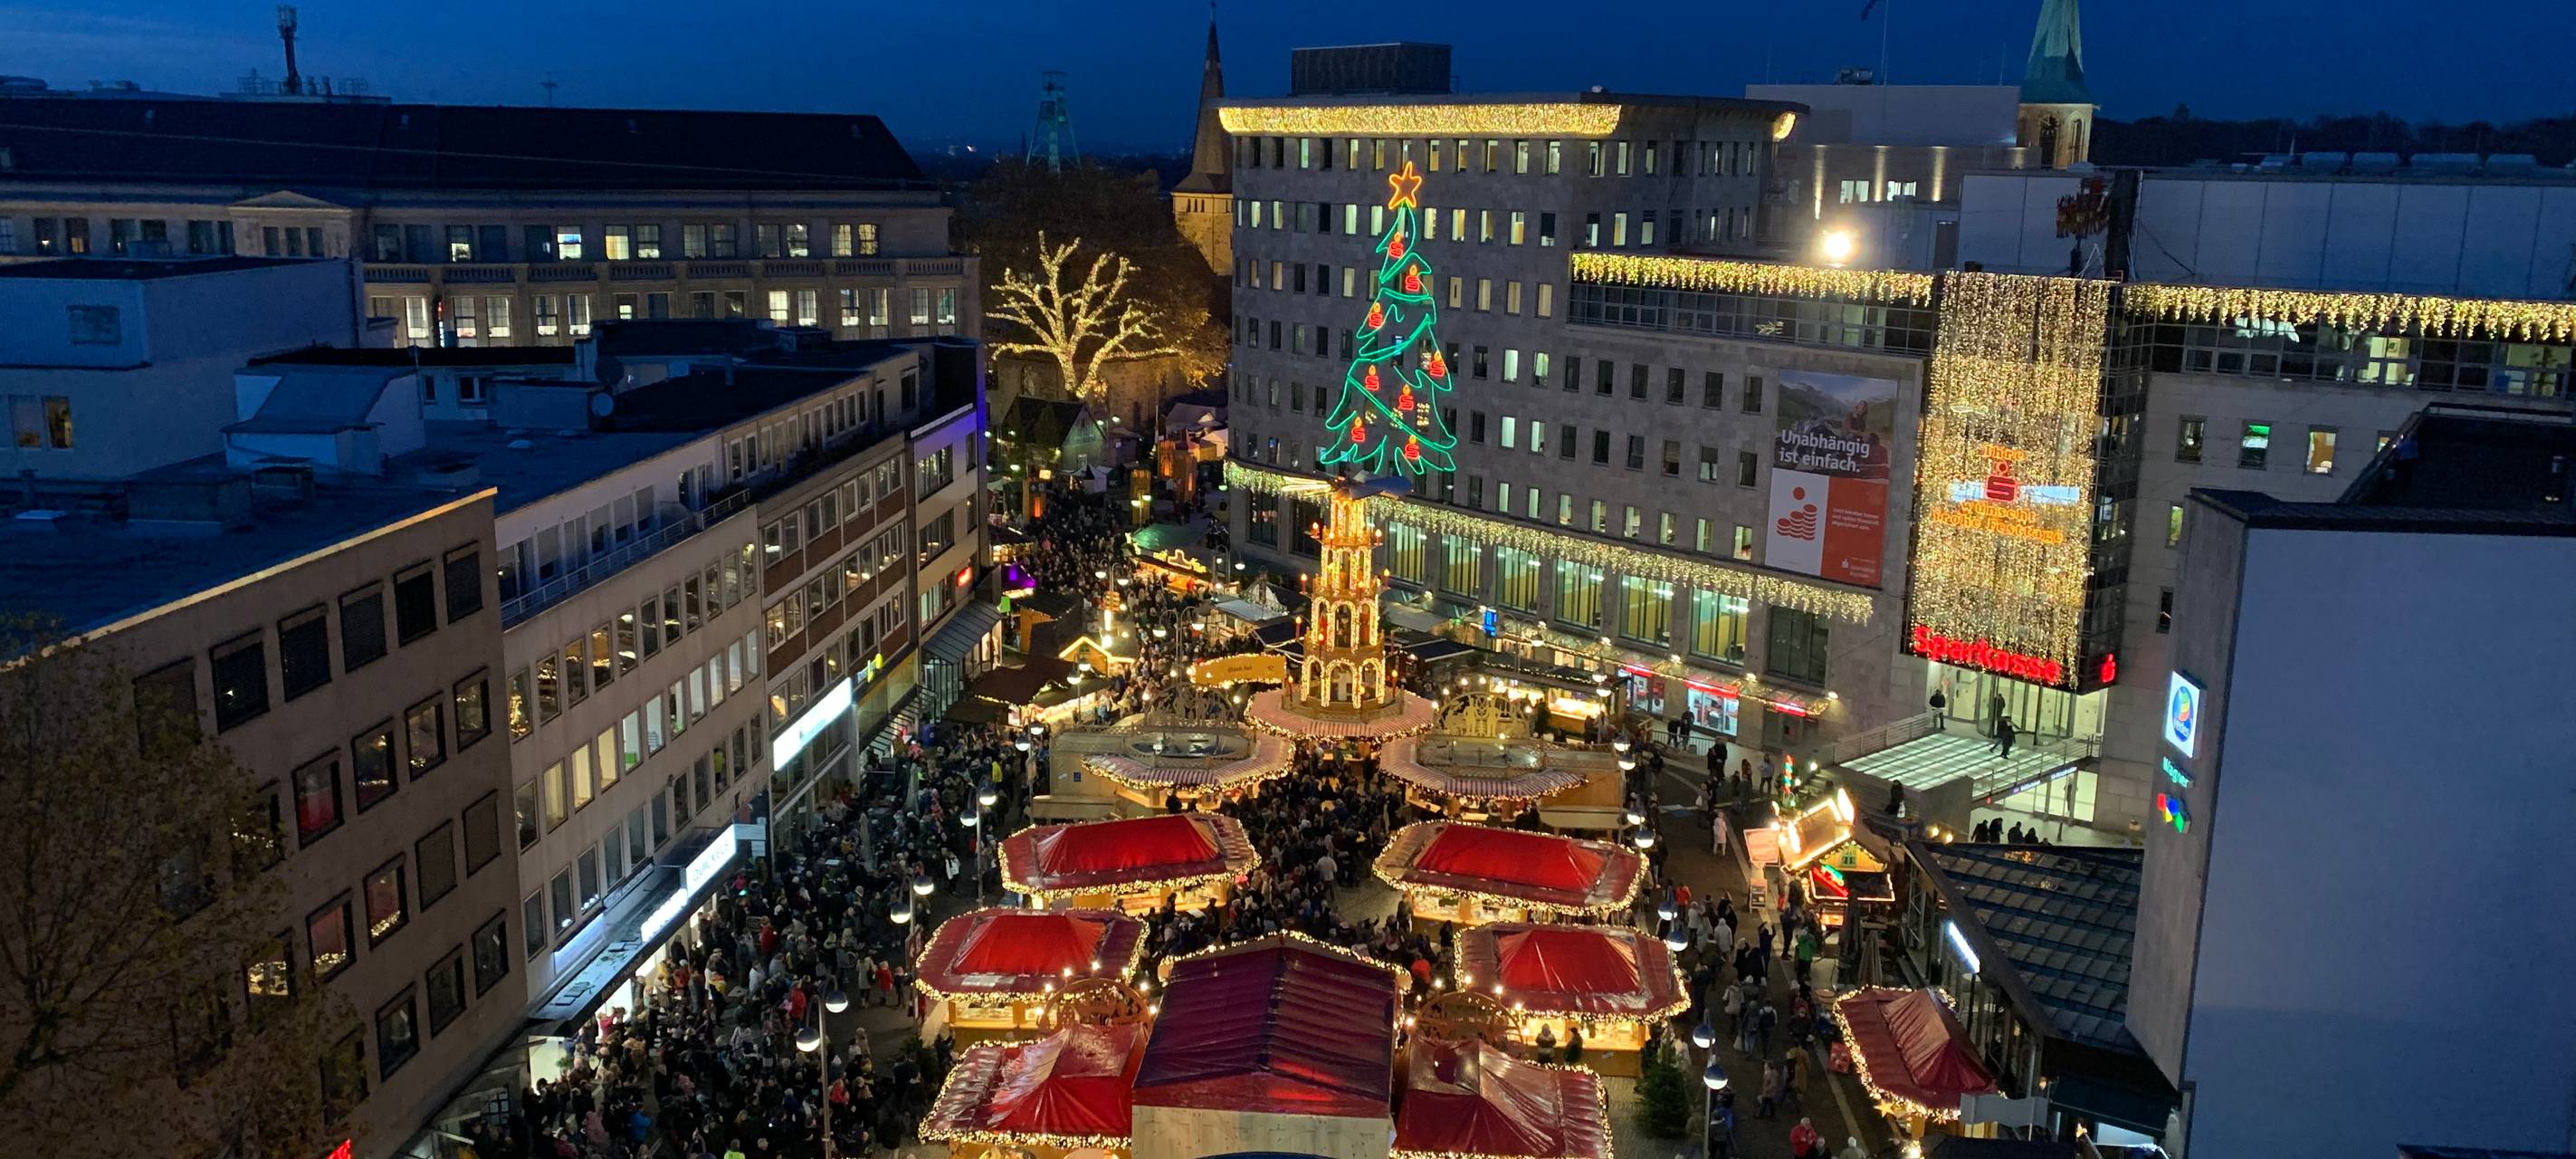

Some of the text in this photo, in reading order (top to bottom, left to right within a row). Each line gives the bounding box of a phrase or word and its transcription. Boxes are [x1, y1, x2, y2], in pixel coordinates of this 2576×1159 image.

[1781, 429, 1870, 458] Unabhängig
[1983, 444, 2027, 462] Ihre
[1779, 447, 1861, 473] ist einfach.
[1961, 501, 2037, 524] wünscht
[1987, 516, 2064, 544] Festtage
[1913, 625, 2063, 686] Sparkasse
